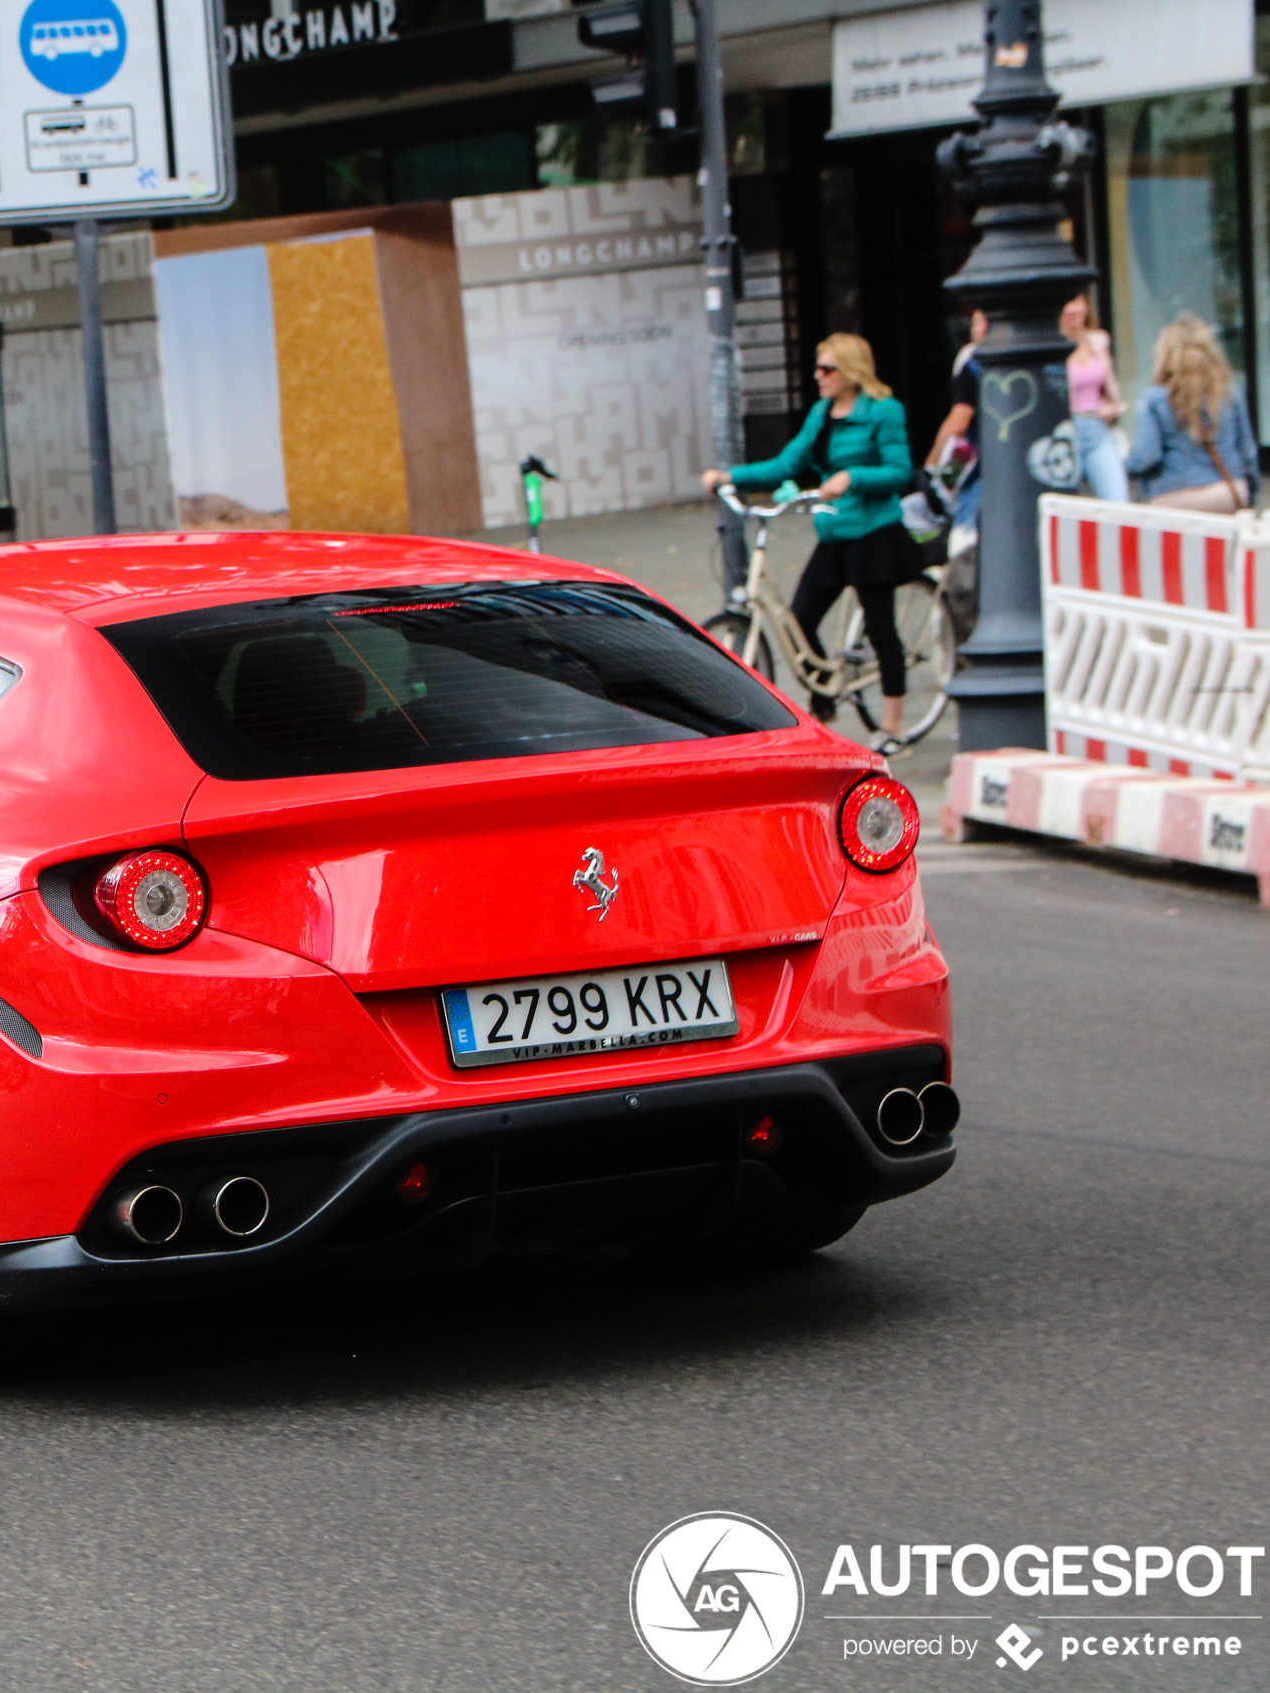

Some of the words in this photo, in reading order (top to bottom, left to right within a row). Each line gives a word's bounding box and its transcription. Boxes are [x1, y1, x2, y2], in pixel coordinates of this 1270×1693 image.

[223, 0, 401, 66] ONGCHAMP
[519, 230, 696, 273] LONGCHAMP
[482, 982, 610, 1044] 2799
[623, 969, 720, 1028] KRX
[458, 1029, 469, 1044] E
[512, 1029, 684, 1059] VIP-MARBELLA.COM
